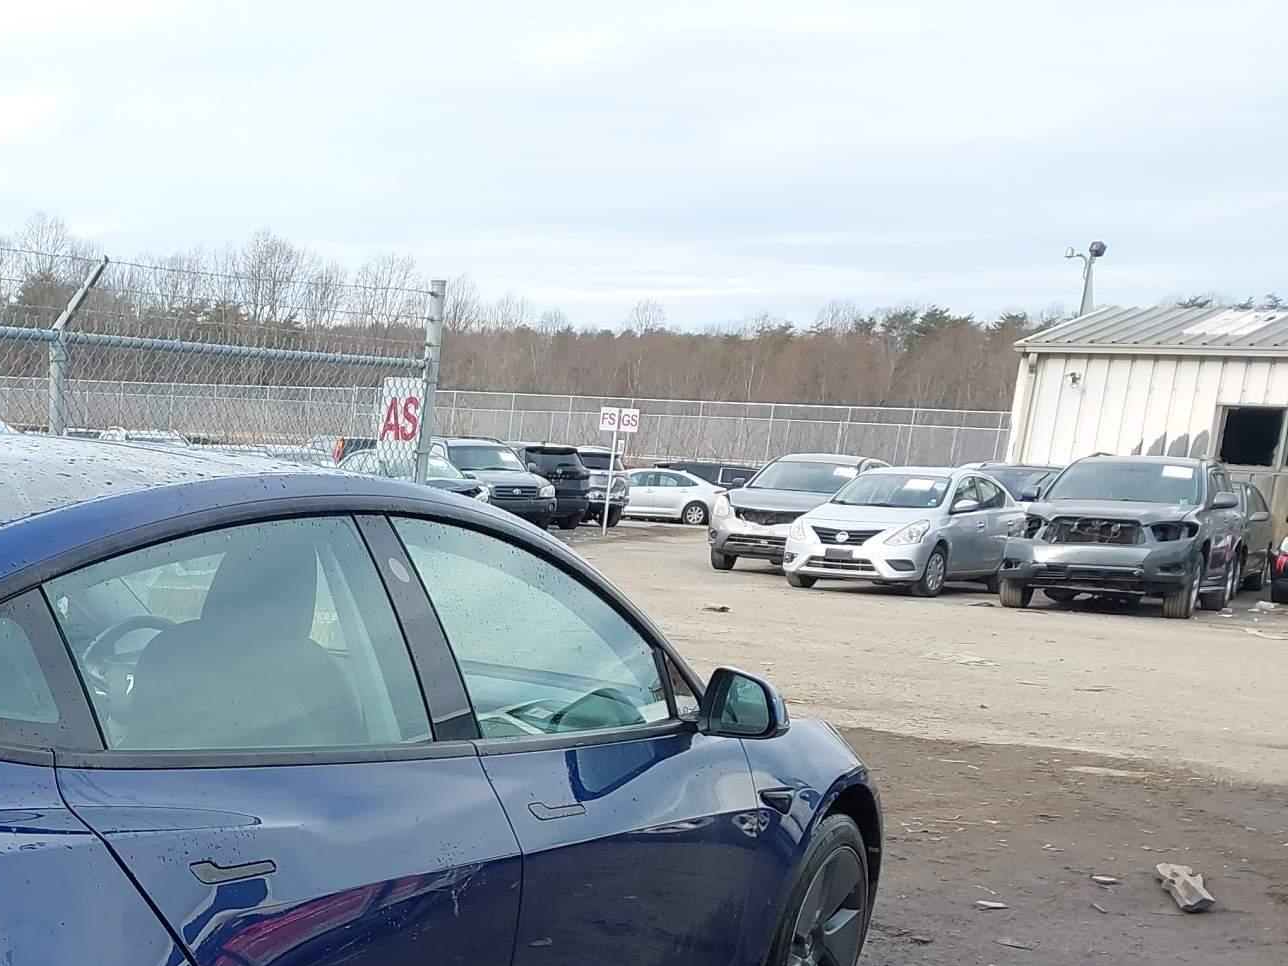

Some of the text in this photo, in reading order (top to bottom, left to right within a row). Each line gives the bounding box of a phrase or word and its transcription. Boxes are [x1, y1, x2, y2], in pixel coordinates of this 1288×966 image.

[380, 396, 420, 441] AS
[601, 412, 616, 426] FS
[621, 414, 638, 427] GS
